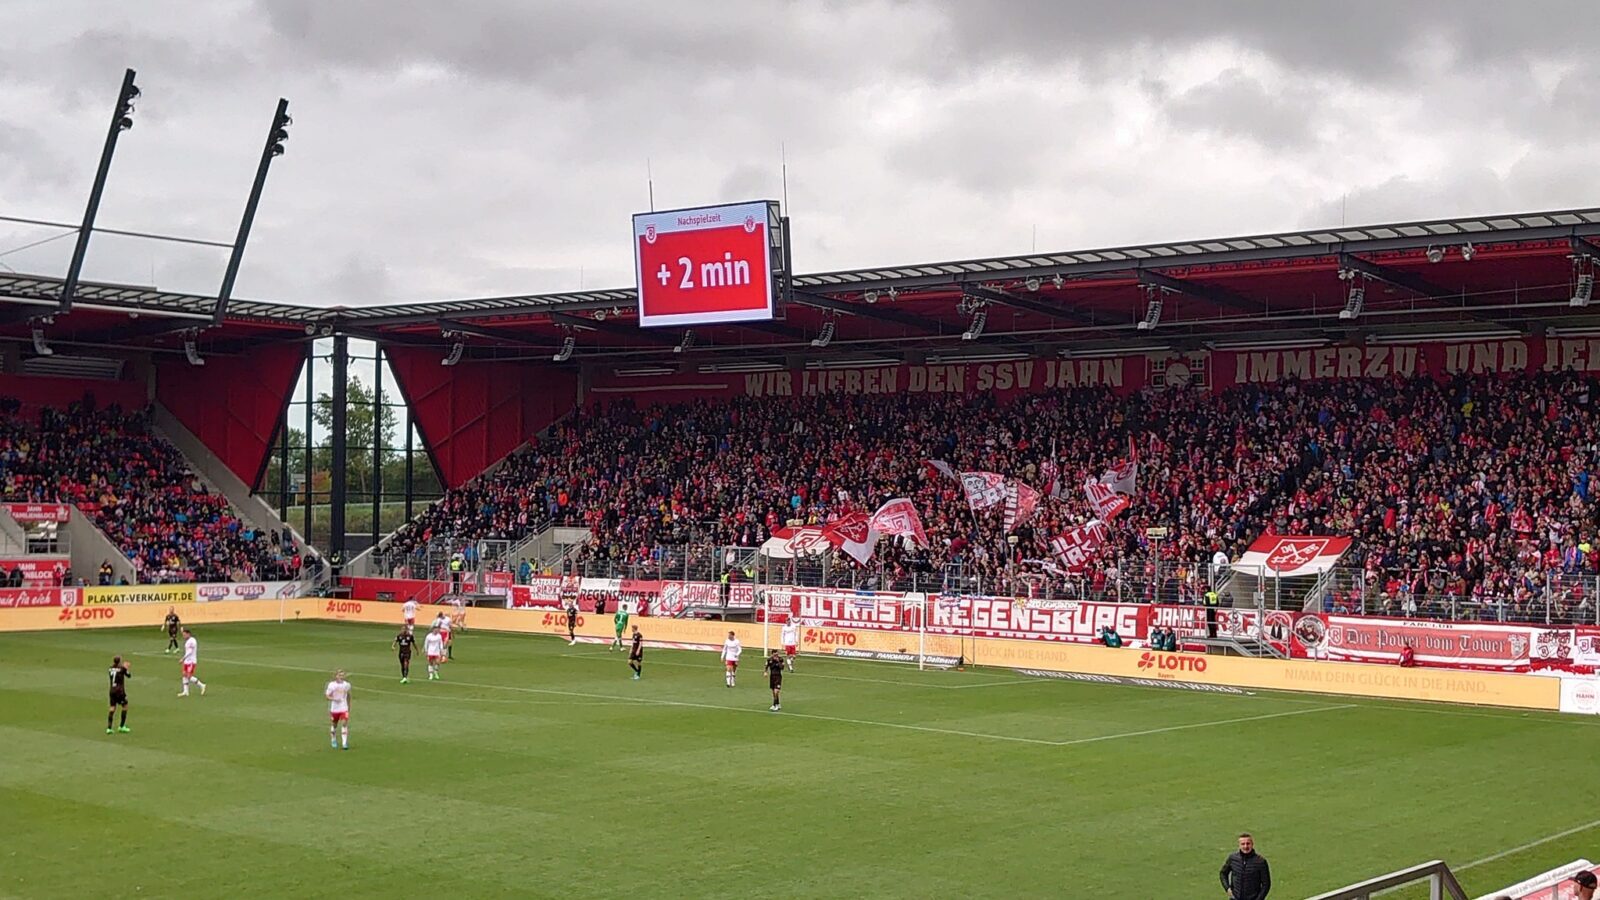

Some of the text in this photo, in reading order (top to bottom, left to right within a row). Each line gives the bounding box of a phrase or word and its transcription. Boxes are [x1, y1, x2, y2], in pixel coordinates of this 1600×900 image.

[678, 214, 721, 226] Nachspielzeit
[657, 252, 750, 289] + 2 min
[1235, 346, 1417, 384] IMMERZU
[1445, 341, 1527, 374] UND
[744, 358, 1123, 397] WIR LIEBEN DEN SSV JAHN
[88, 592, 192, 603] PLAKAT-VERKAUFT.DE
[76, 608, 114, 619] LOTTO
[337, 601, 362, 613] LOTTO
[800, 592, 1139, 637] ULTRAS REGENSBURG
[555, 614, 584, 627] LOO
[1153, 608, 1193, 628] JAHN
[820, 631, 857, 645] LOTTO
[1426, 634, 1454, 651] vom
[1459, 633, 1506, 653] Tower
[1158, 655, 1207, 672] LOTTO
